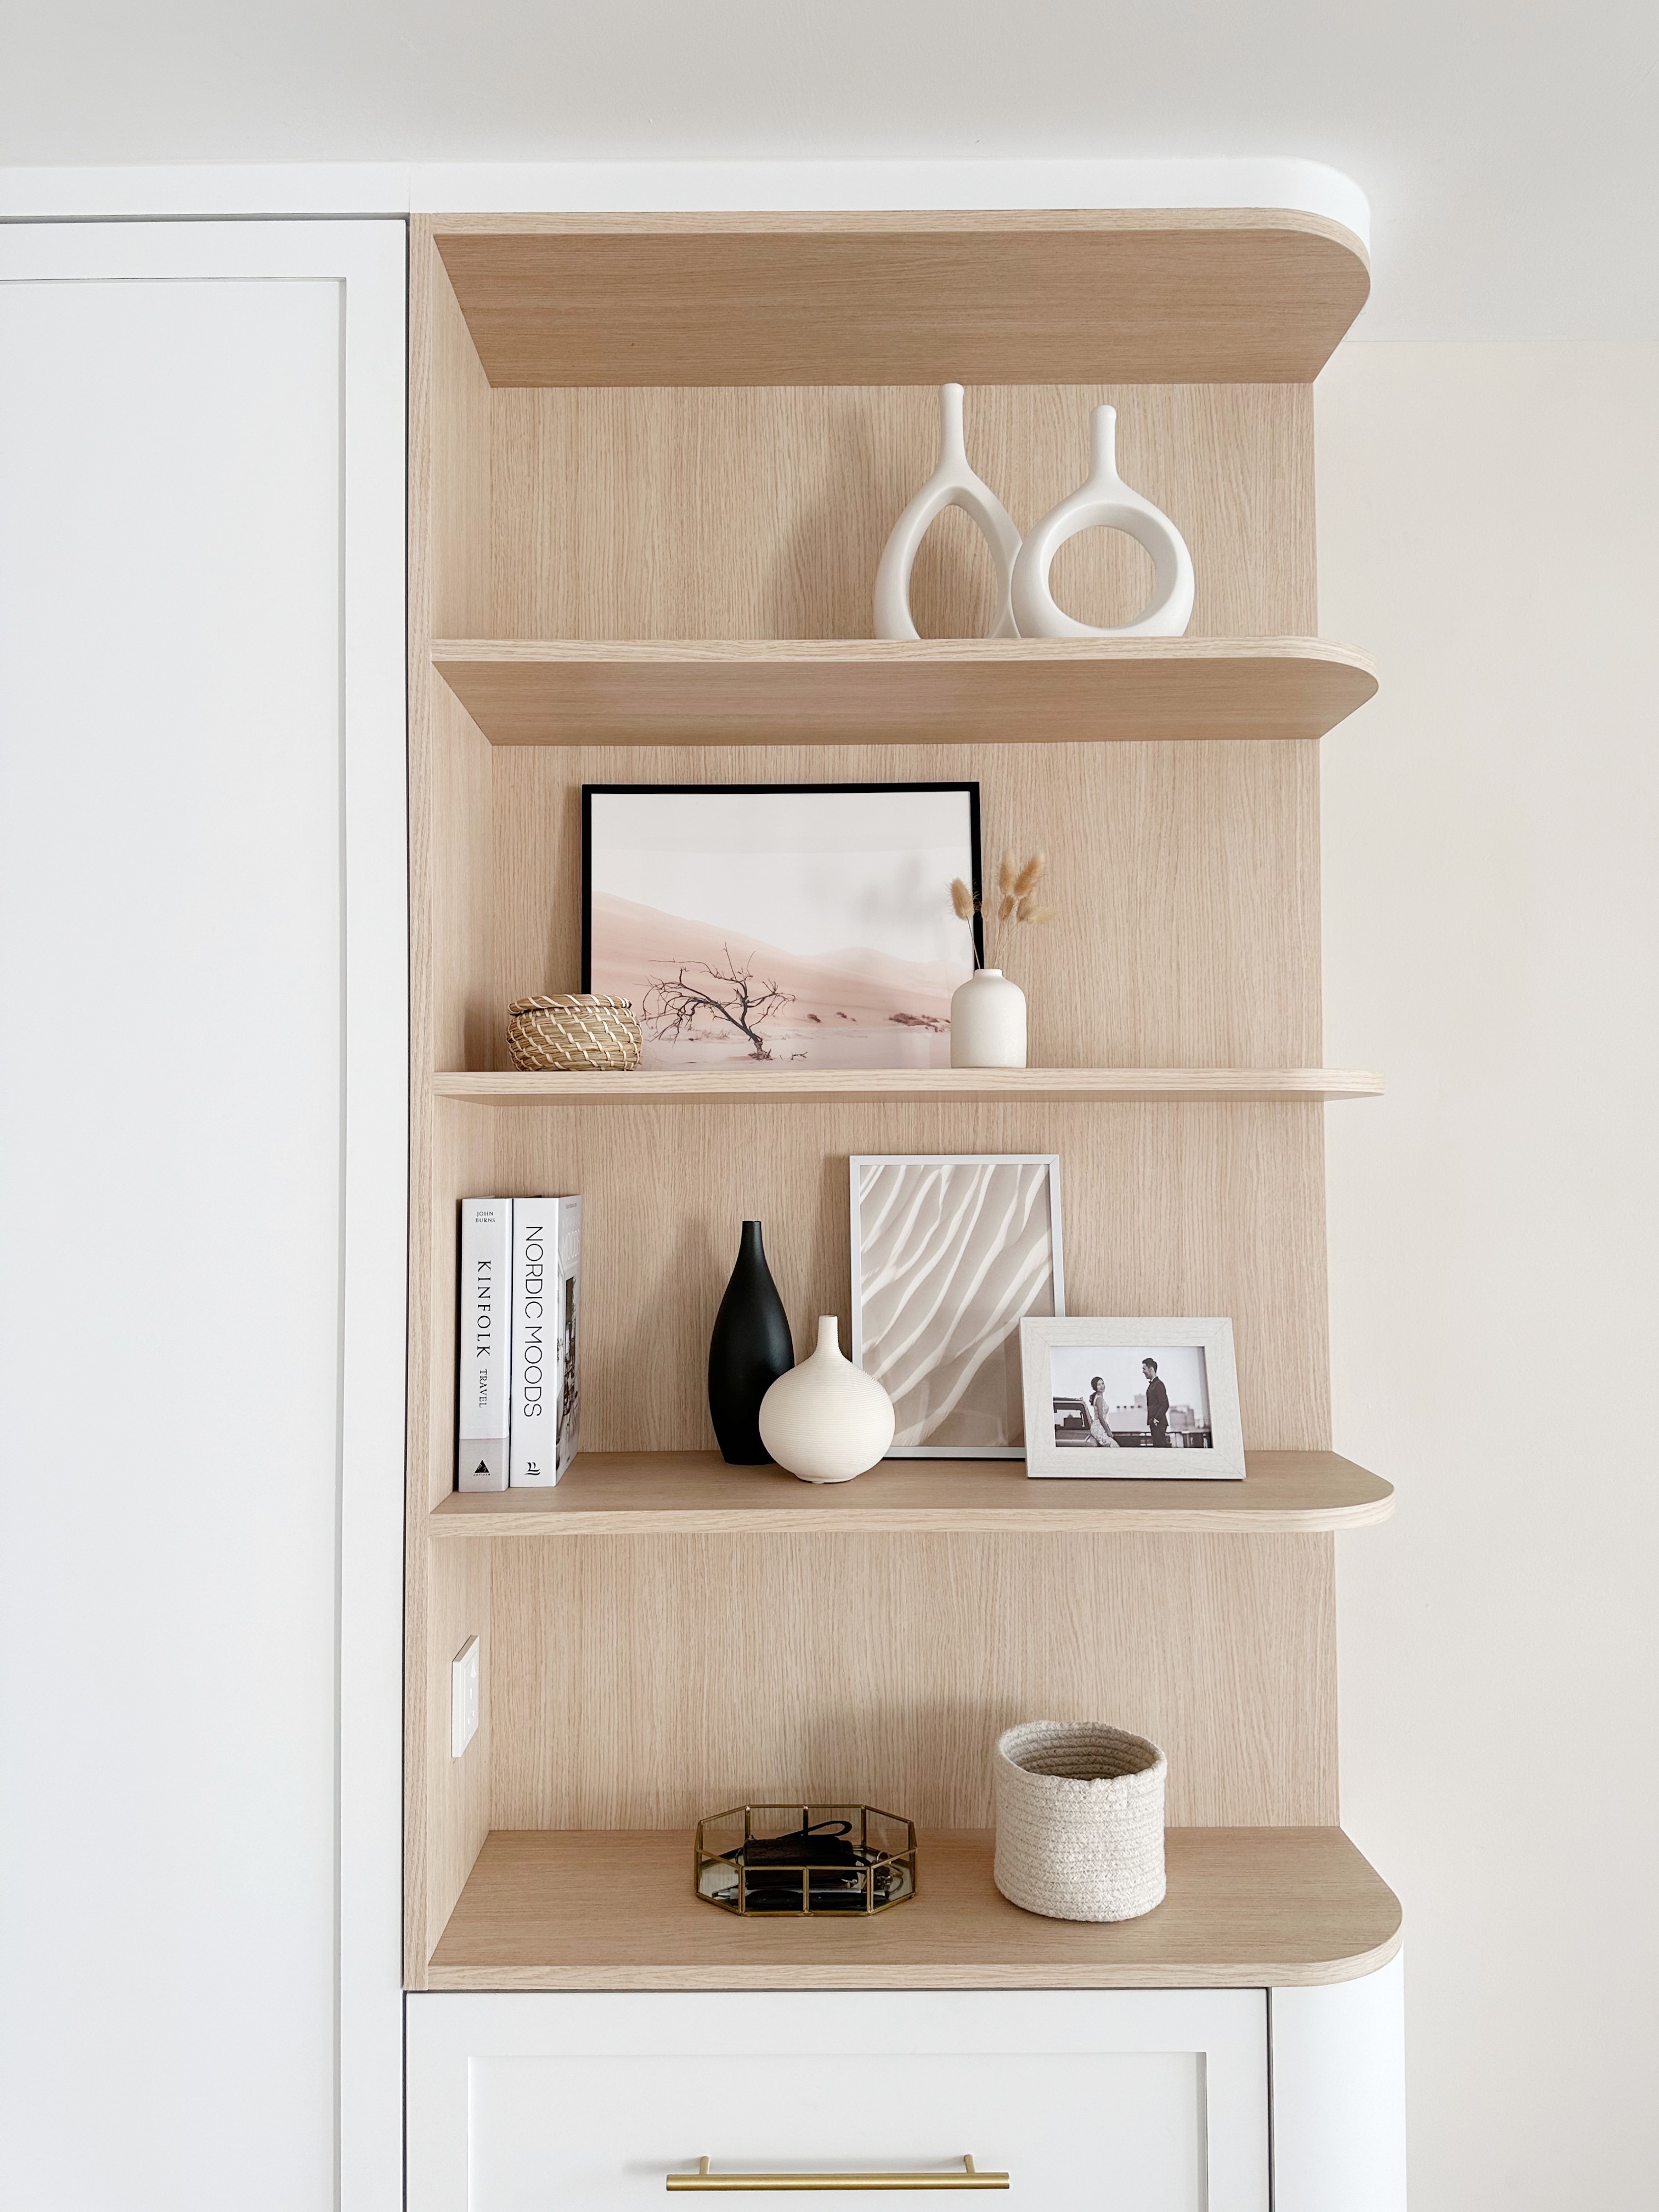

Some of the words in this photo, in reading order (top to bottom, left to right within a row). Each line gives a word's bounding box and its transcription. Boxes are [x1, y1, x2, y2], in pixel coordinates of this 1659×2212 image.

[477, 1260, 492, 1358] KINFOLK
[525, 1226, 543, 1319] NORDIC
[479, 1368, 487, 1408] TRAVEL
[524, 1327, 543, 1417] MOODS
